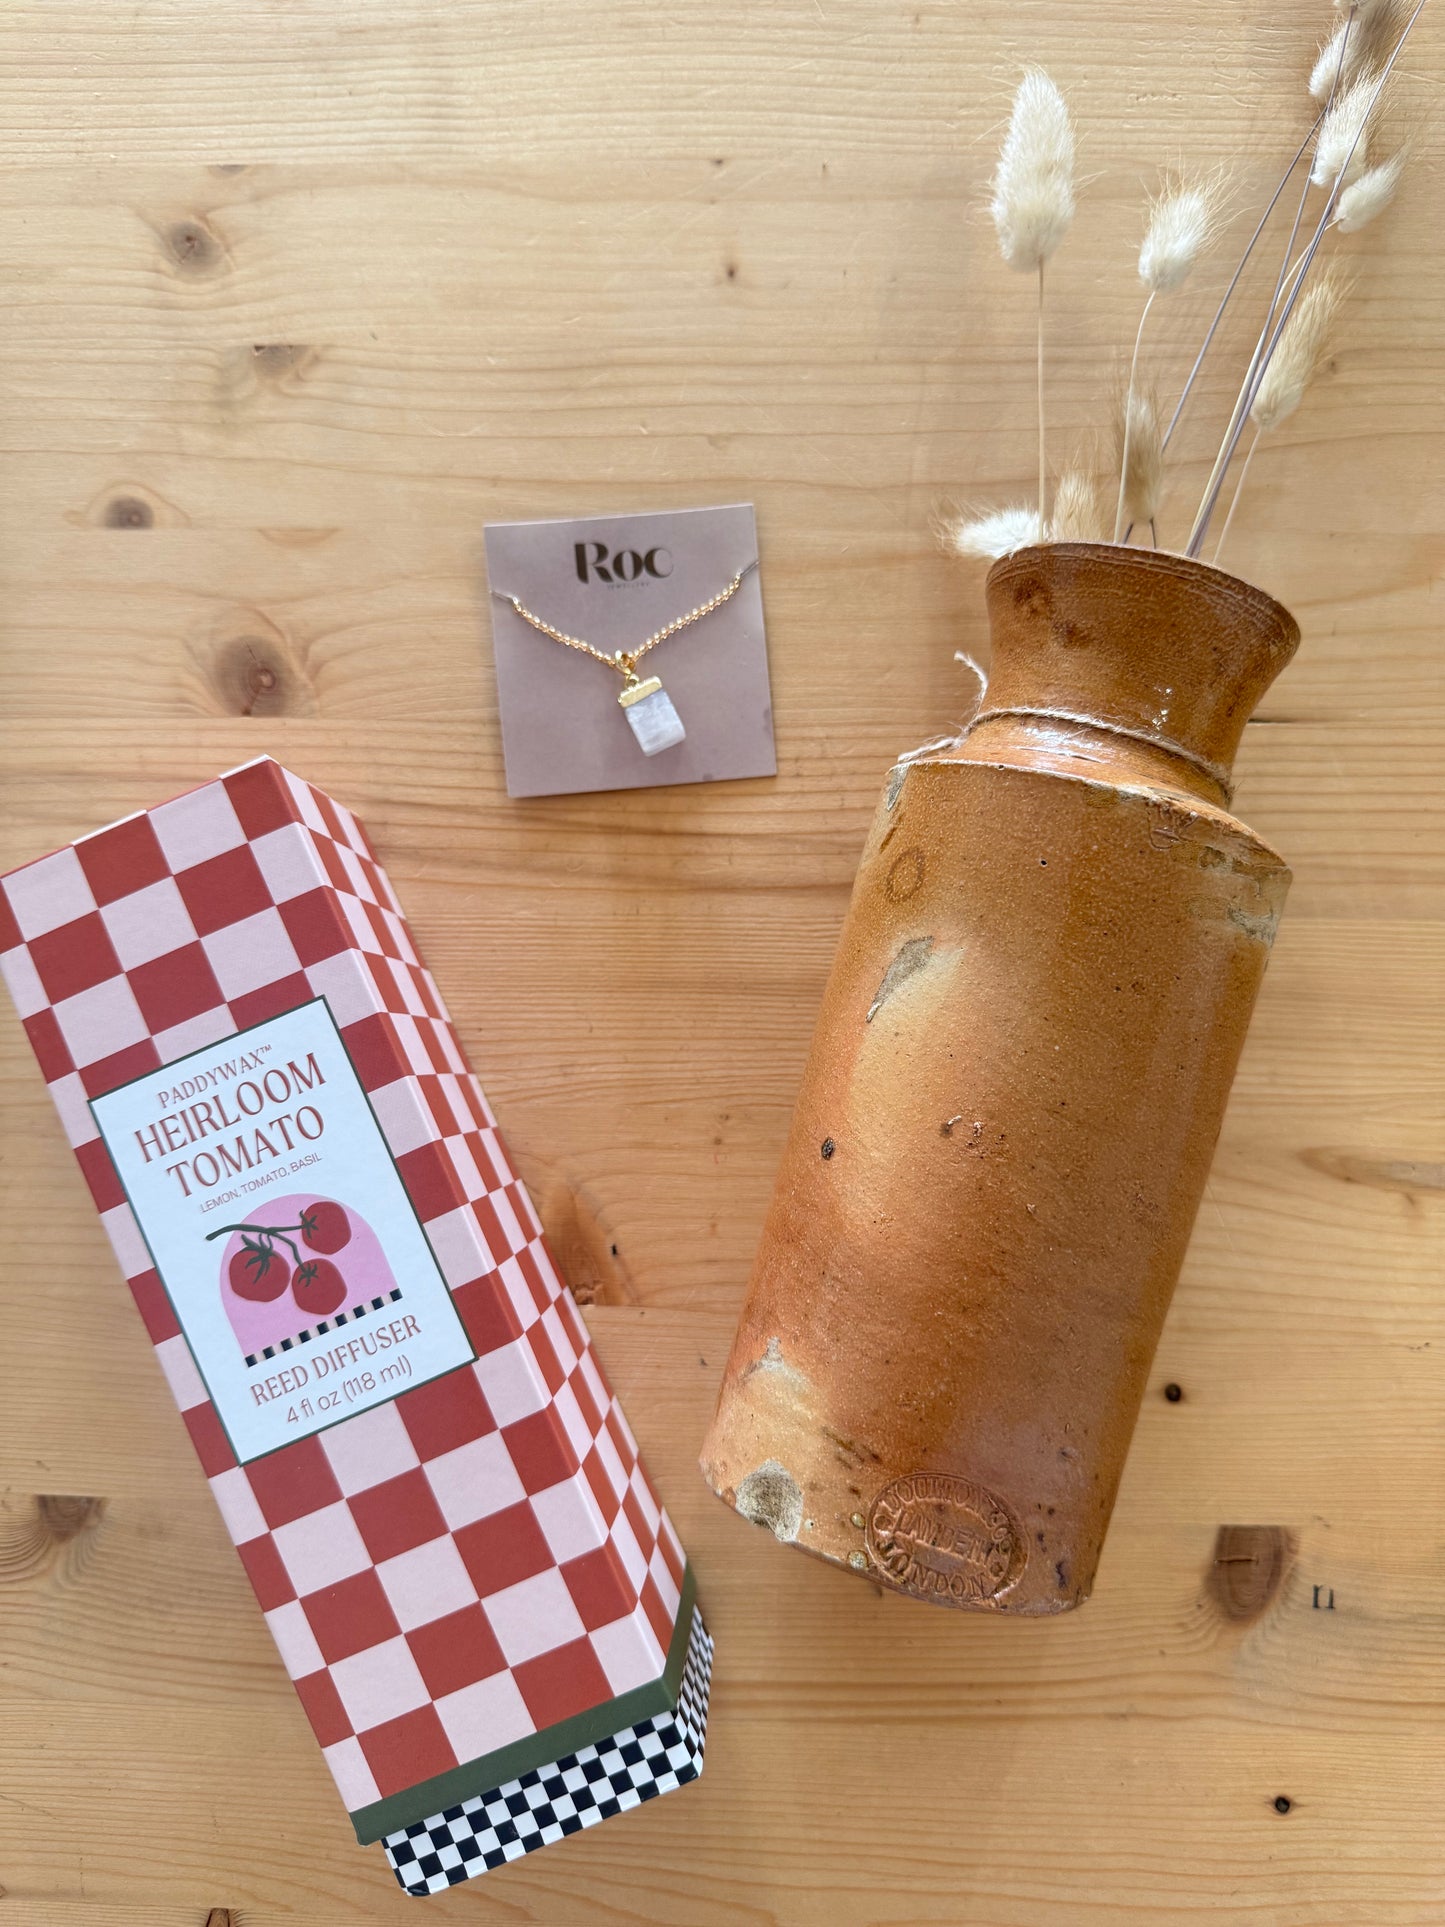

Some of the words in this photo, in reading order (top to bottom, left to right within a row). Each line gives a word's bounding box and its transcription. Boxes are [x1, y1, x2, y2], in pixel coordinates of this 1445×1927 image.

[133, 1052, 327, 1163] HEIRLOOM
[166, 1105, 325, 1197] TOMATO
[199, 1188, 242, 1213] LEMON,
[240, 1166, 290, 1195] TOMATO,
[290, 1152, 323, 1174] BASIL
[250, 1365, 309, 1407] REED
[311, 1314, 422, 1379] DIFFUSER
[287, 1406, 299, 1424] 4
[301, 1397, 315, 1418] fl
[317, 1390, 342, 1411] oz
[343, 1371, 376, 1403] (118
[380, 1354, 412, 1384] ml)
[875, 1540, 991, 1599] LONDON
